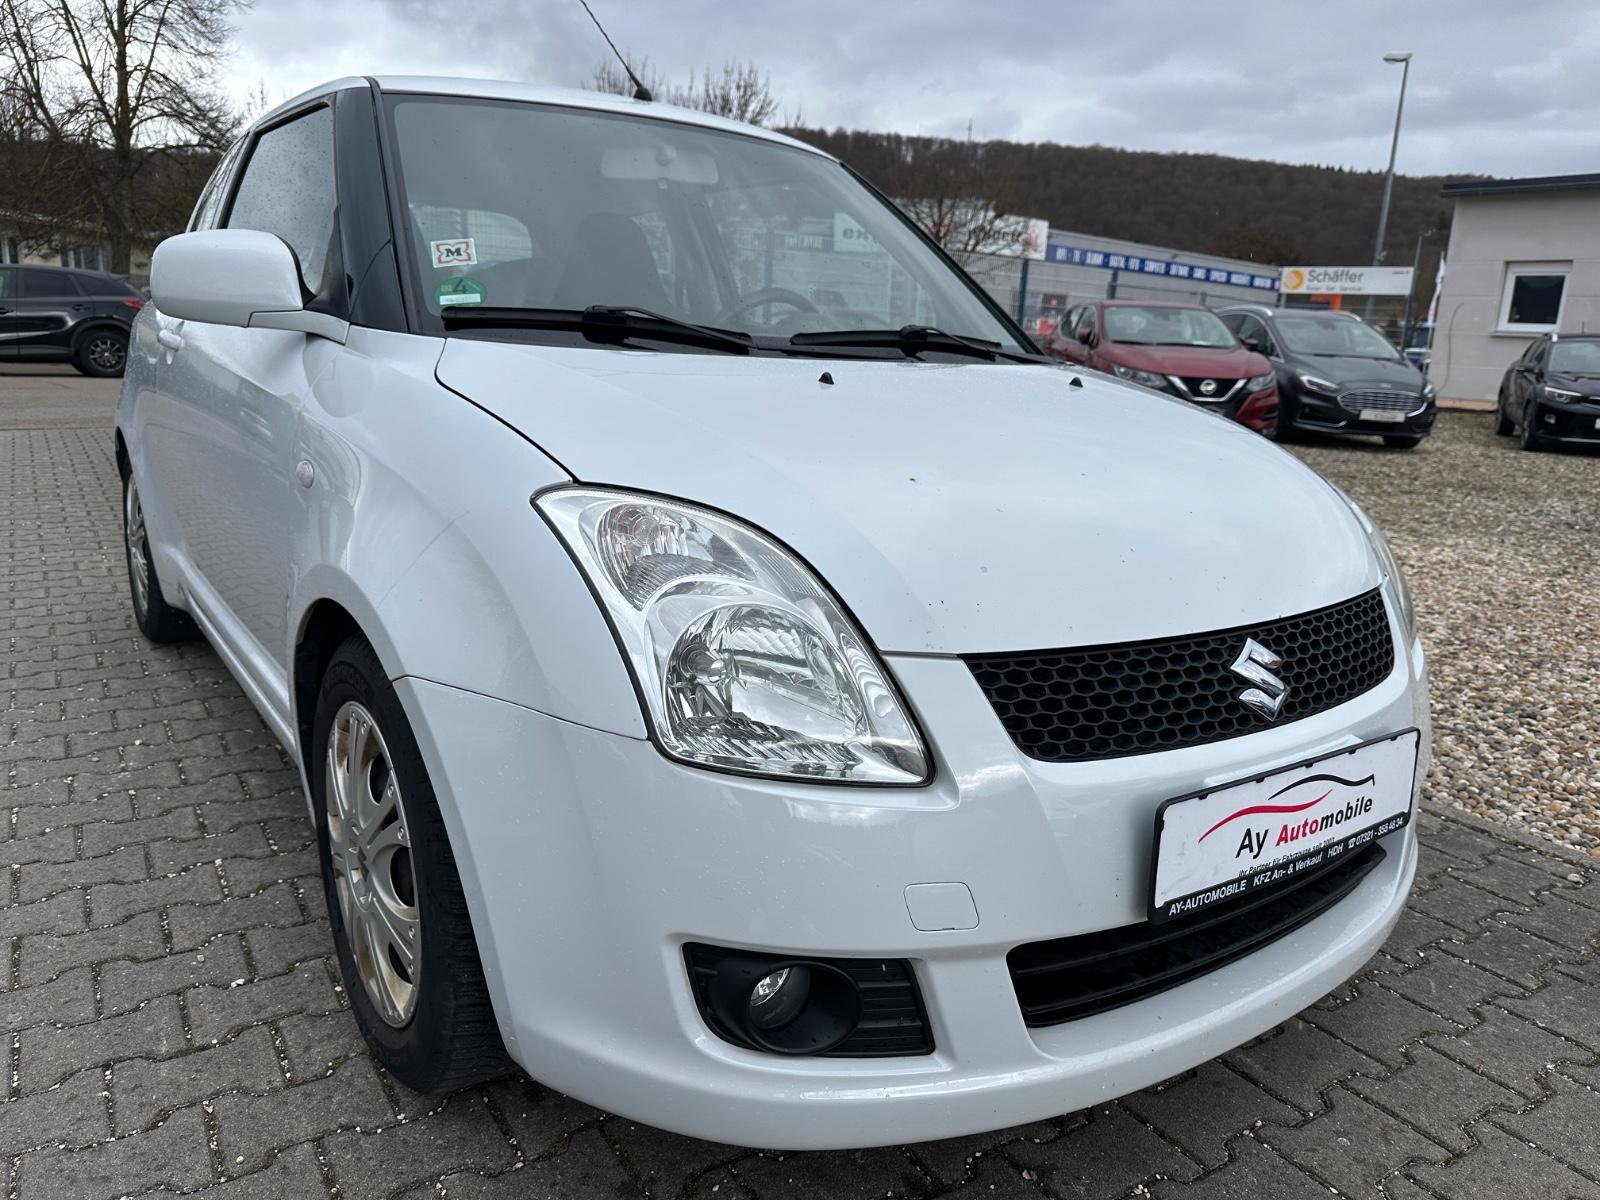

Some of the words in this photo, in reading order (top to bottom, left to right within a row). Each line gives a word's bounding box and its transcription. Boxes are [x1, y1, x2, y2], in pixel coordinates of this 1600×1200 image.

[453, 278, 468, 294] 4
[1307, 269, 1364, 283] Schäffer
[1235, 827, 1269, 860] Ay
[1275, 796, 1373, 847] Automobile
[1168, 879, 1247, 916] AY-AUTOMOBILE
[1253, 871, 1273, 887] KFZ
[1272, 868, 1287, 881] An-
[1287, 864, 1294, 875] &
[1295, 851, 1323, 872] Verkauf
[1327, 842, 1344, 858] HDH
